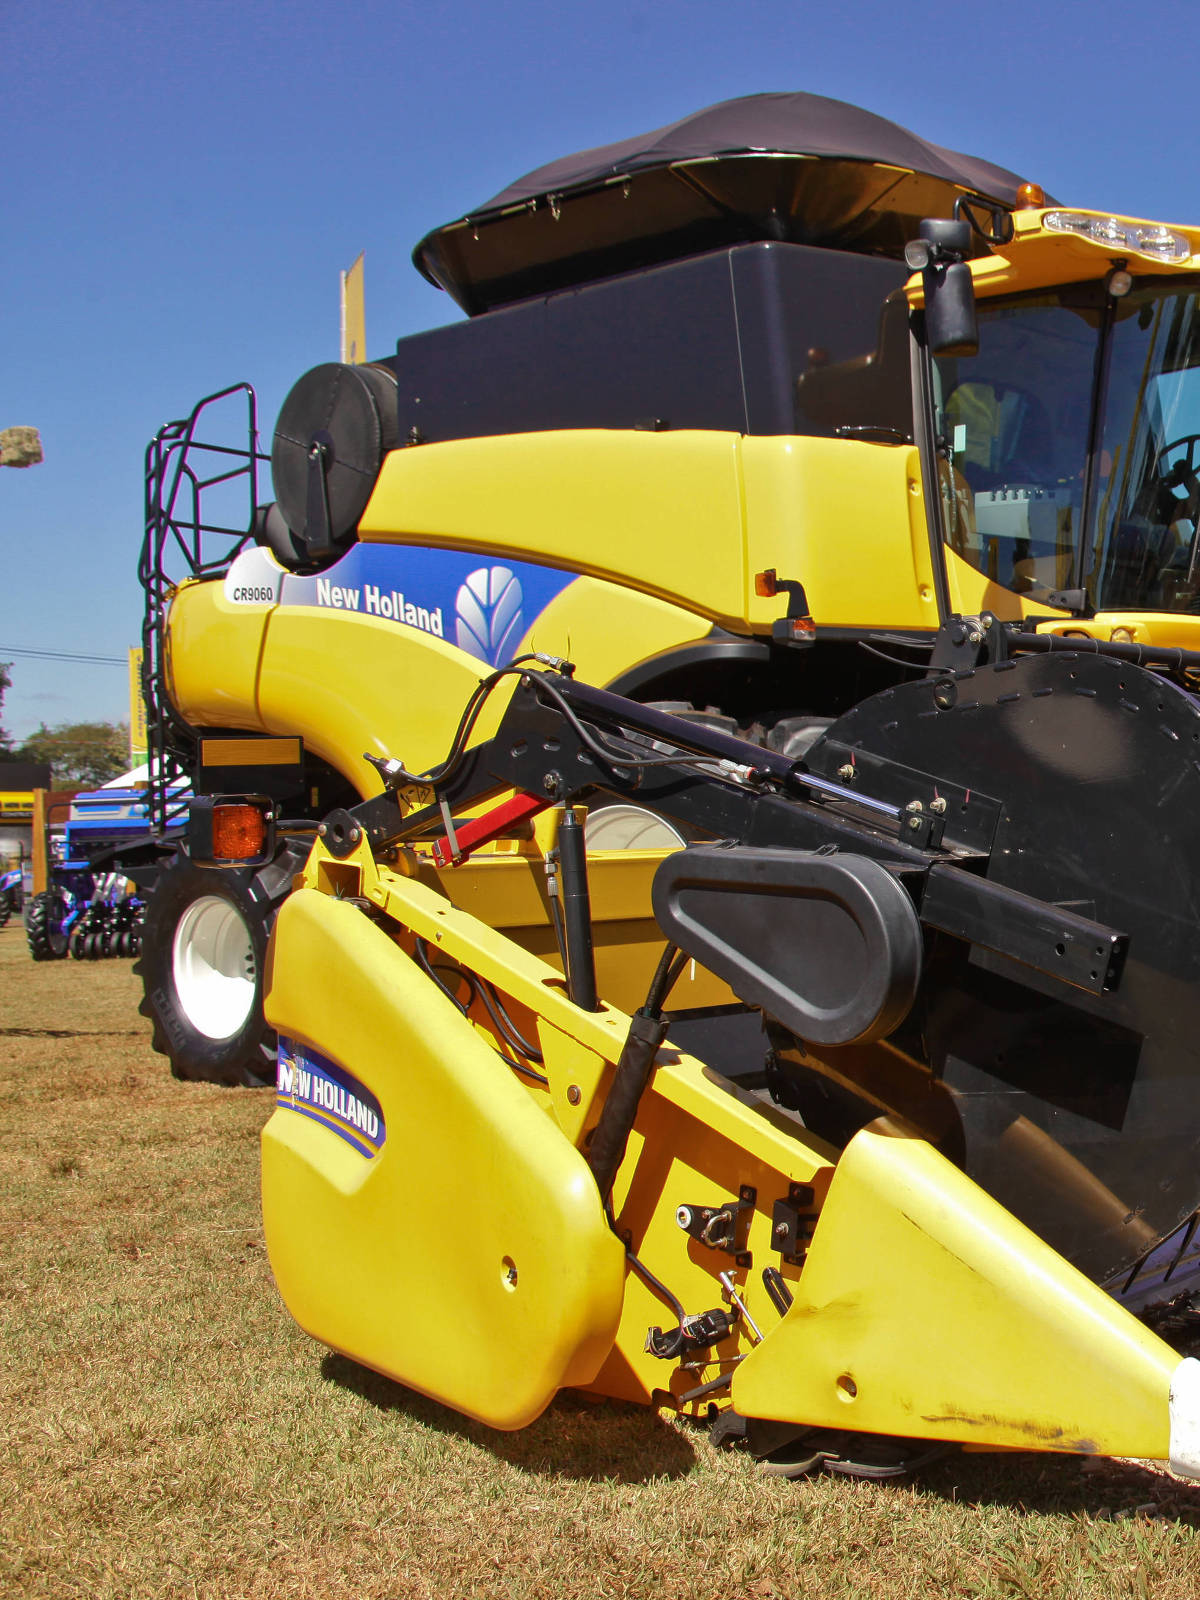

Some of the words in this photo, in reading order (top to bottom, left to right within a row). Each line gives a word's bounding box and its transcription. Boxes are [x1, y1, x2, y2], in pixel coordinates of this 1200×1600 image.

[233, 586, 273, 601] CR9060
[316, 578, 360, 610] New
[364, 584, 444, 637] Holland
[313, 1075, 379, 1139] HOLLAND
